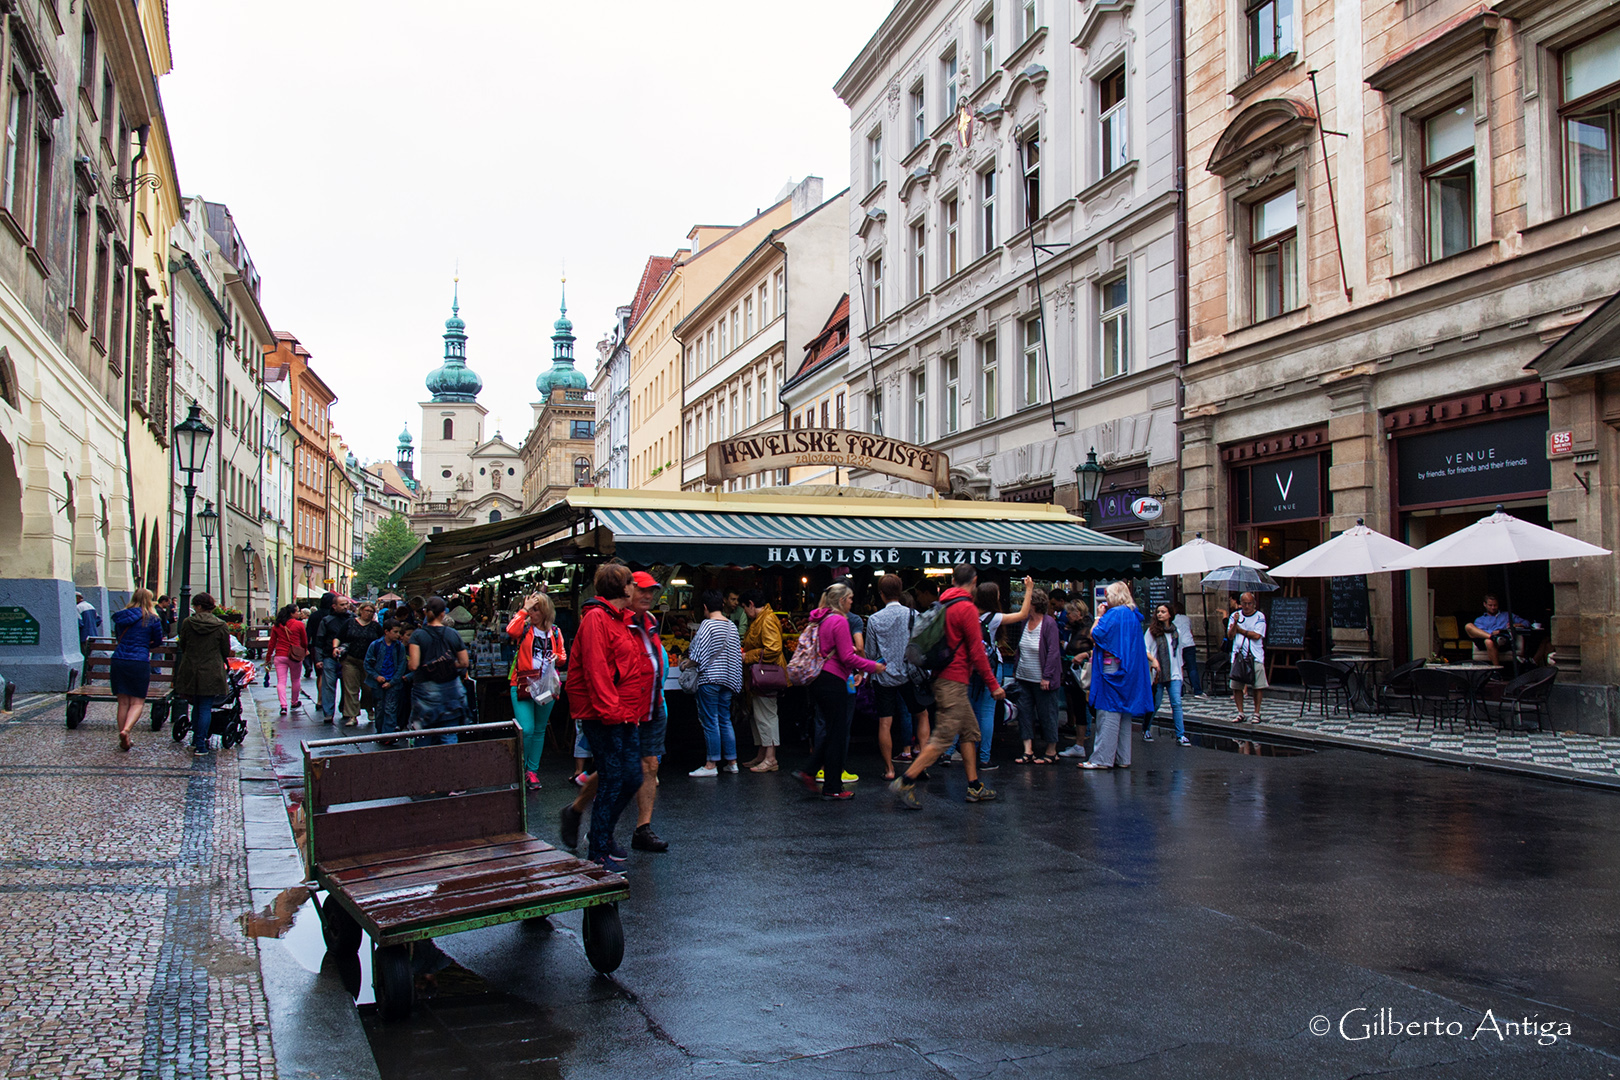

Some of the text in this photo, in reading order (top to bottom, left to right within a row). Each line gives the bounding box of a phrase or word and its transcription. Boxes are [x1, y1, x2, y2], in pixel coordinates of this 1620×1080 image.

[1554, 432, 1571, 444] 525
[846, 454, 873, 468] 1232
[1445, 448, 1495, 465] VENUE
[1417, 472, 1426, 480] by
[1456, 464, 1477, 474] friends
[1477, 462, 1489, 470] and
[1490, 461, 1504, 469] their
[1505, 457, 1527, 467] friends
[1275, 470, 1293, 501] V
[1273, 503, 1296, 511] VENUE
[767, 547, 1022, 565] HAVELSKÉ TRŽIŠTĚ
